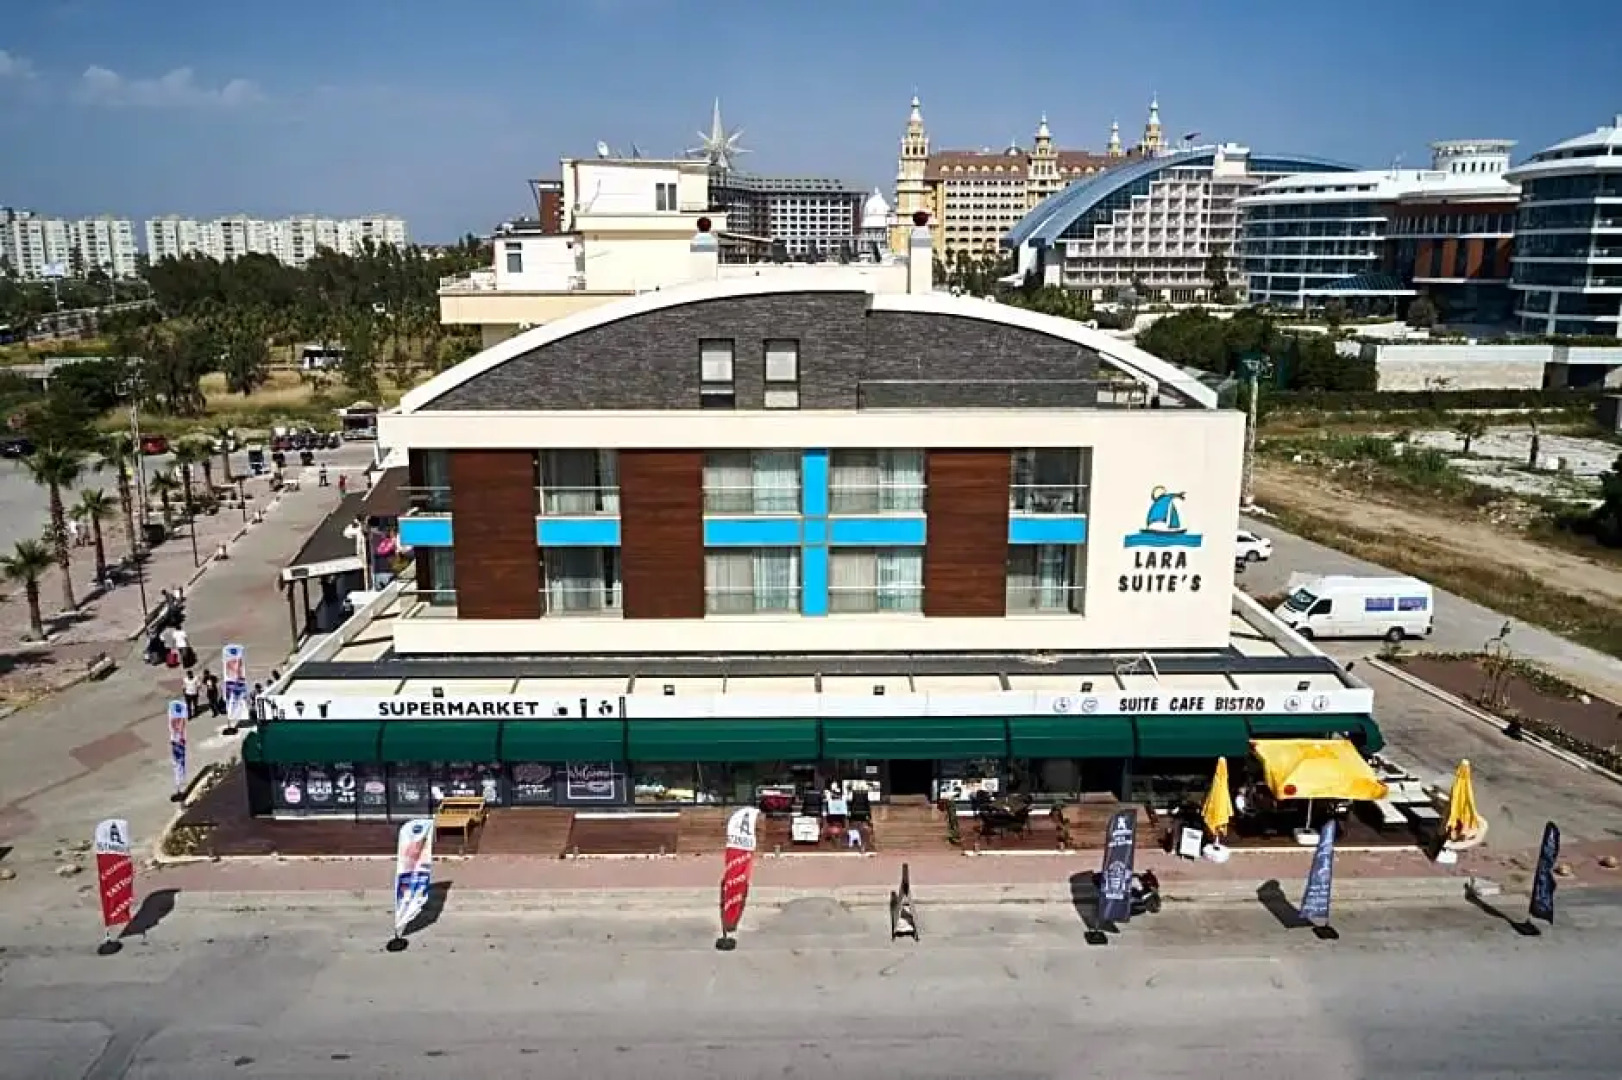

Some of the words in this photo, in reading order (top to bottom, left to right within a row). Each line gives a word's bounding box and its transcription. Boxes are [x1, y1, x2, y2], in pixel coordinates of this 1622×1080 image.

[1134, 551, 1188, 569] LARA
[1118, 574, 1202, 593] SUITE'S
[378, 701, 539, 717] SUPERMARKET
[1119, 696, 1160, 712] SUITE
[1169, 696, 1205, 712] CAFE
[1214, 696, 1266, 712] BISTRO
